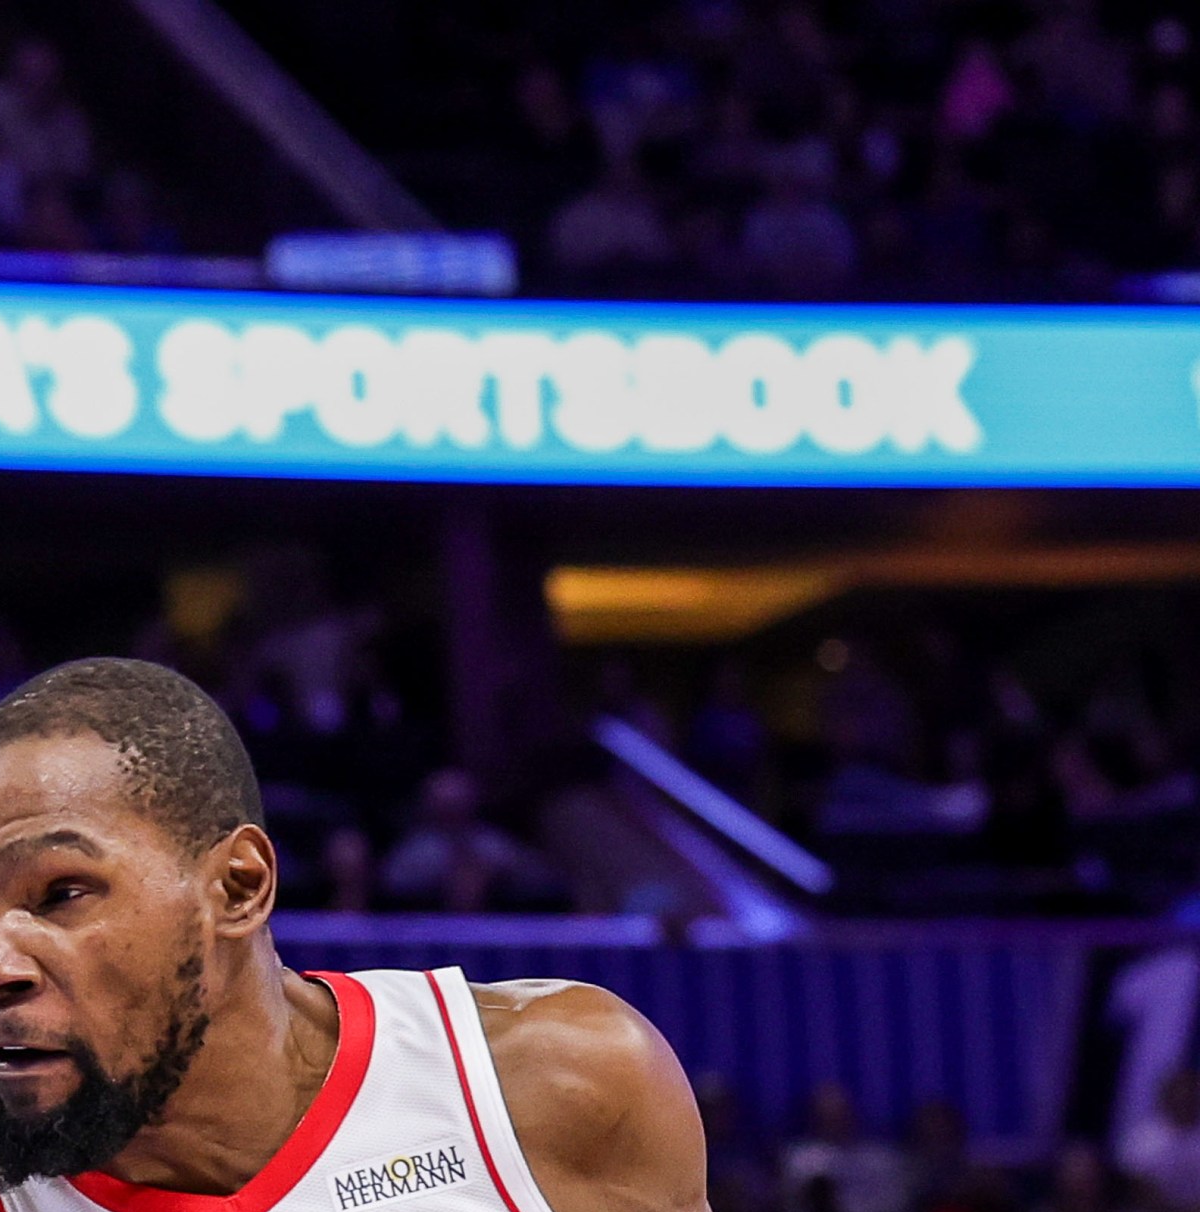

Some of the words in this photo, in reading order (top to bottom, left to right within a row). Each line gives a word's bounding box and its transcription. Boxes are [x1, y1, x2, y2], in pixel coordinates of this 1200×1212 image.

[158, 317, 984, 454] SPORTSBOOK
[335, 1146, 464, 1195] MEMORIAL
[337, 1161, 466, 1210] HERMANN
